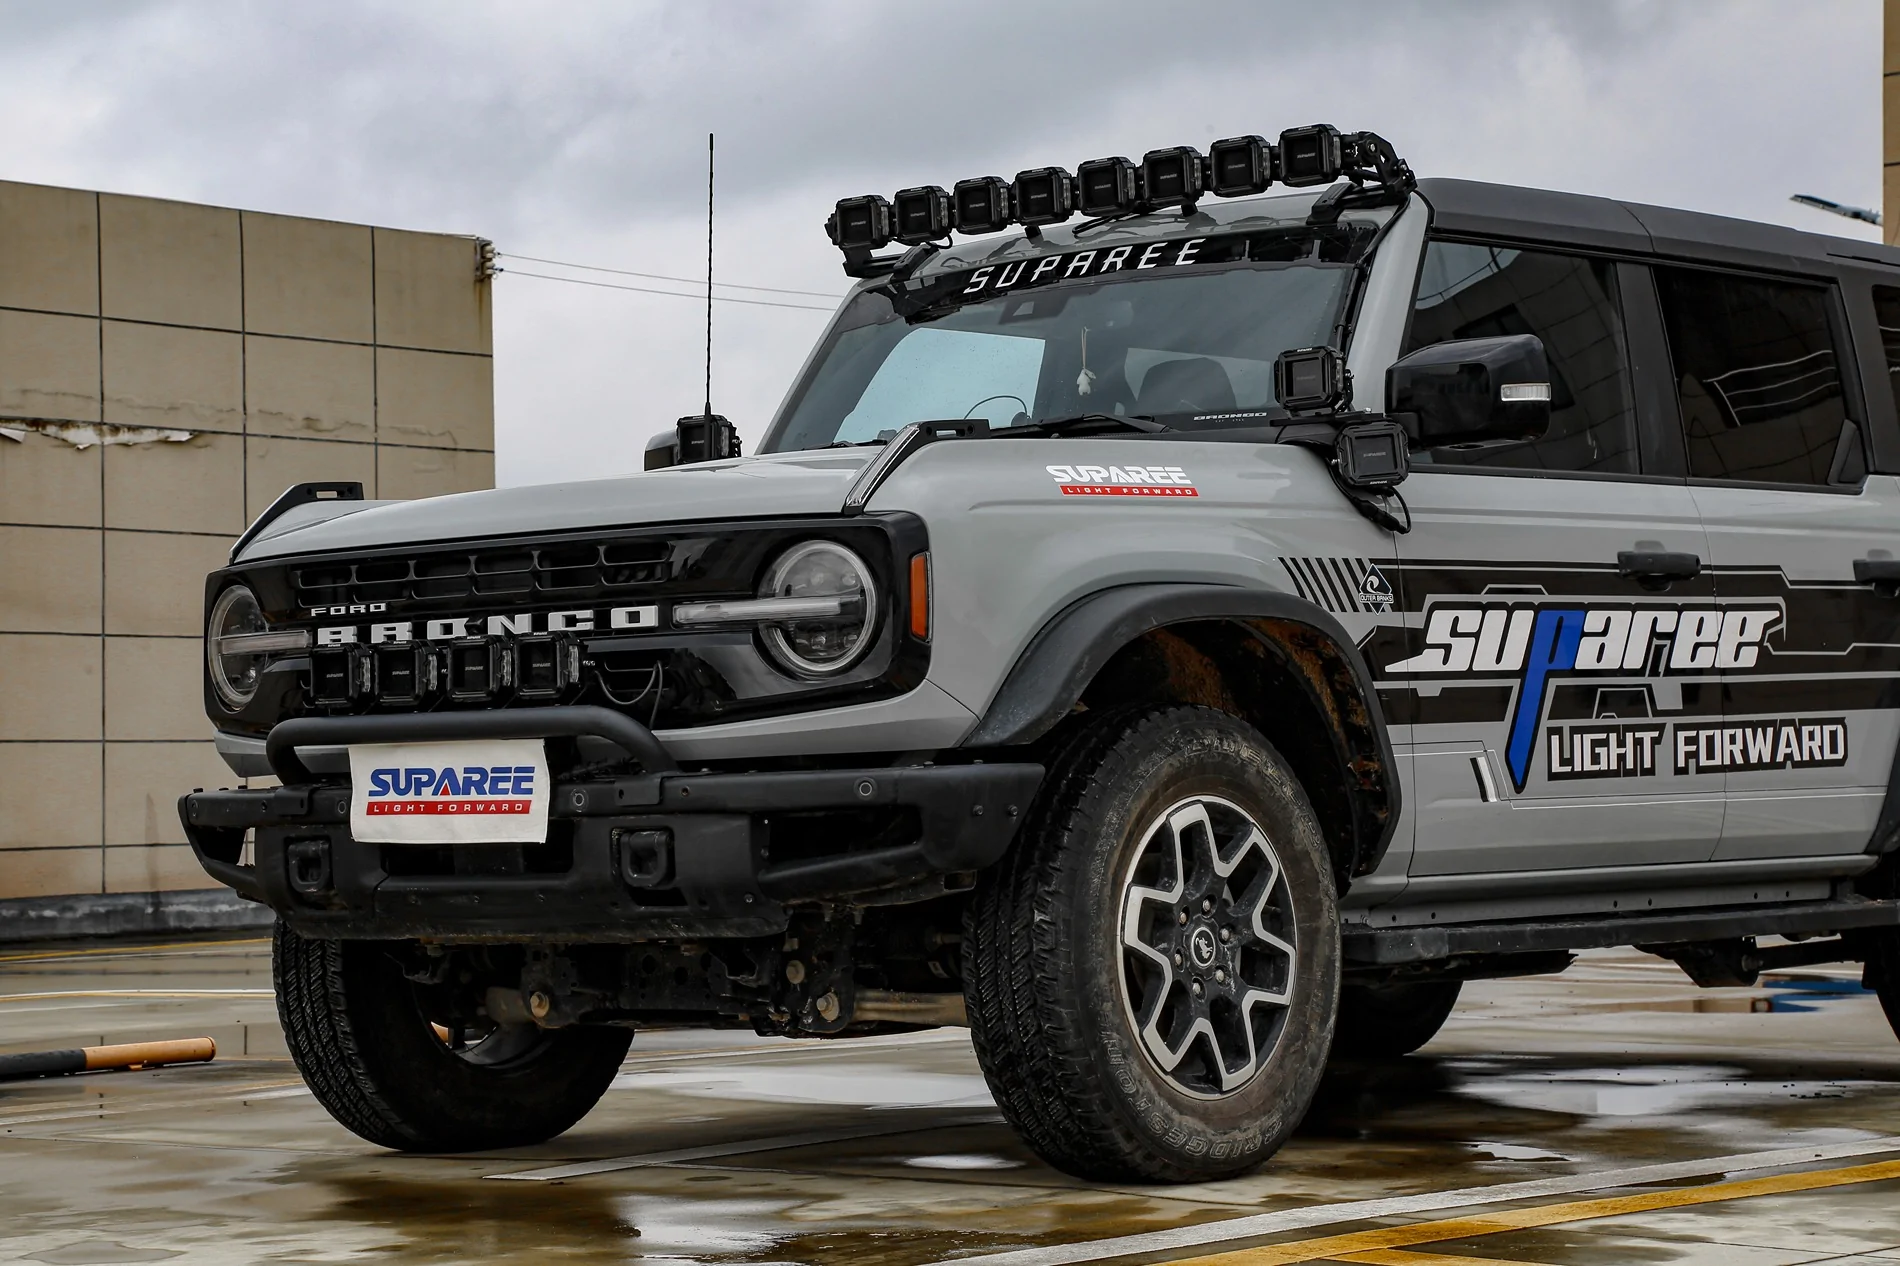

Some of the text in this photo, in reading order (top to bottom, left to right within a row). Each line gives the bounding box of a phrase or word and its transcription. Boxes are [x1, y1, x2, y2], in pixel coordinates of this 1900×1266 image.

[963, 238, 1206, 294] SUPAREE
[1045, 465, 1192, 485] SUPAREE
[1067, 486, 1192, 496] LIGHT FORWARD
[311, 603, 386, 617] FORD
[317, 605, 659, 645] BRONCO
[1550, 724, 1846, 773] LIGHT FORWARD
[368, 766, 535, 797] SUPAREE
[374, 803, 523, 813] LIGHT FORWARD
